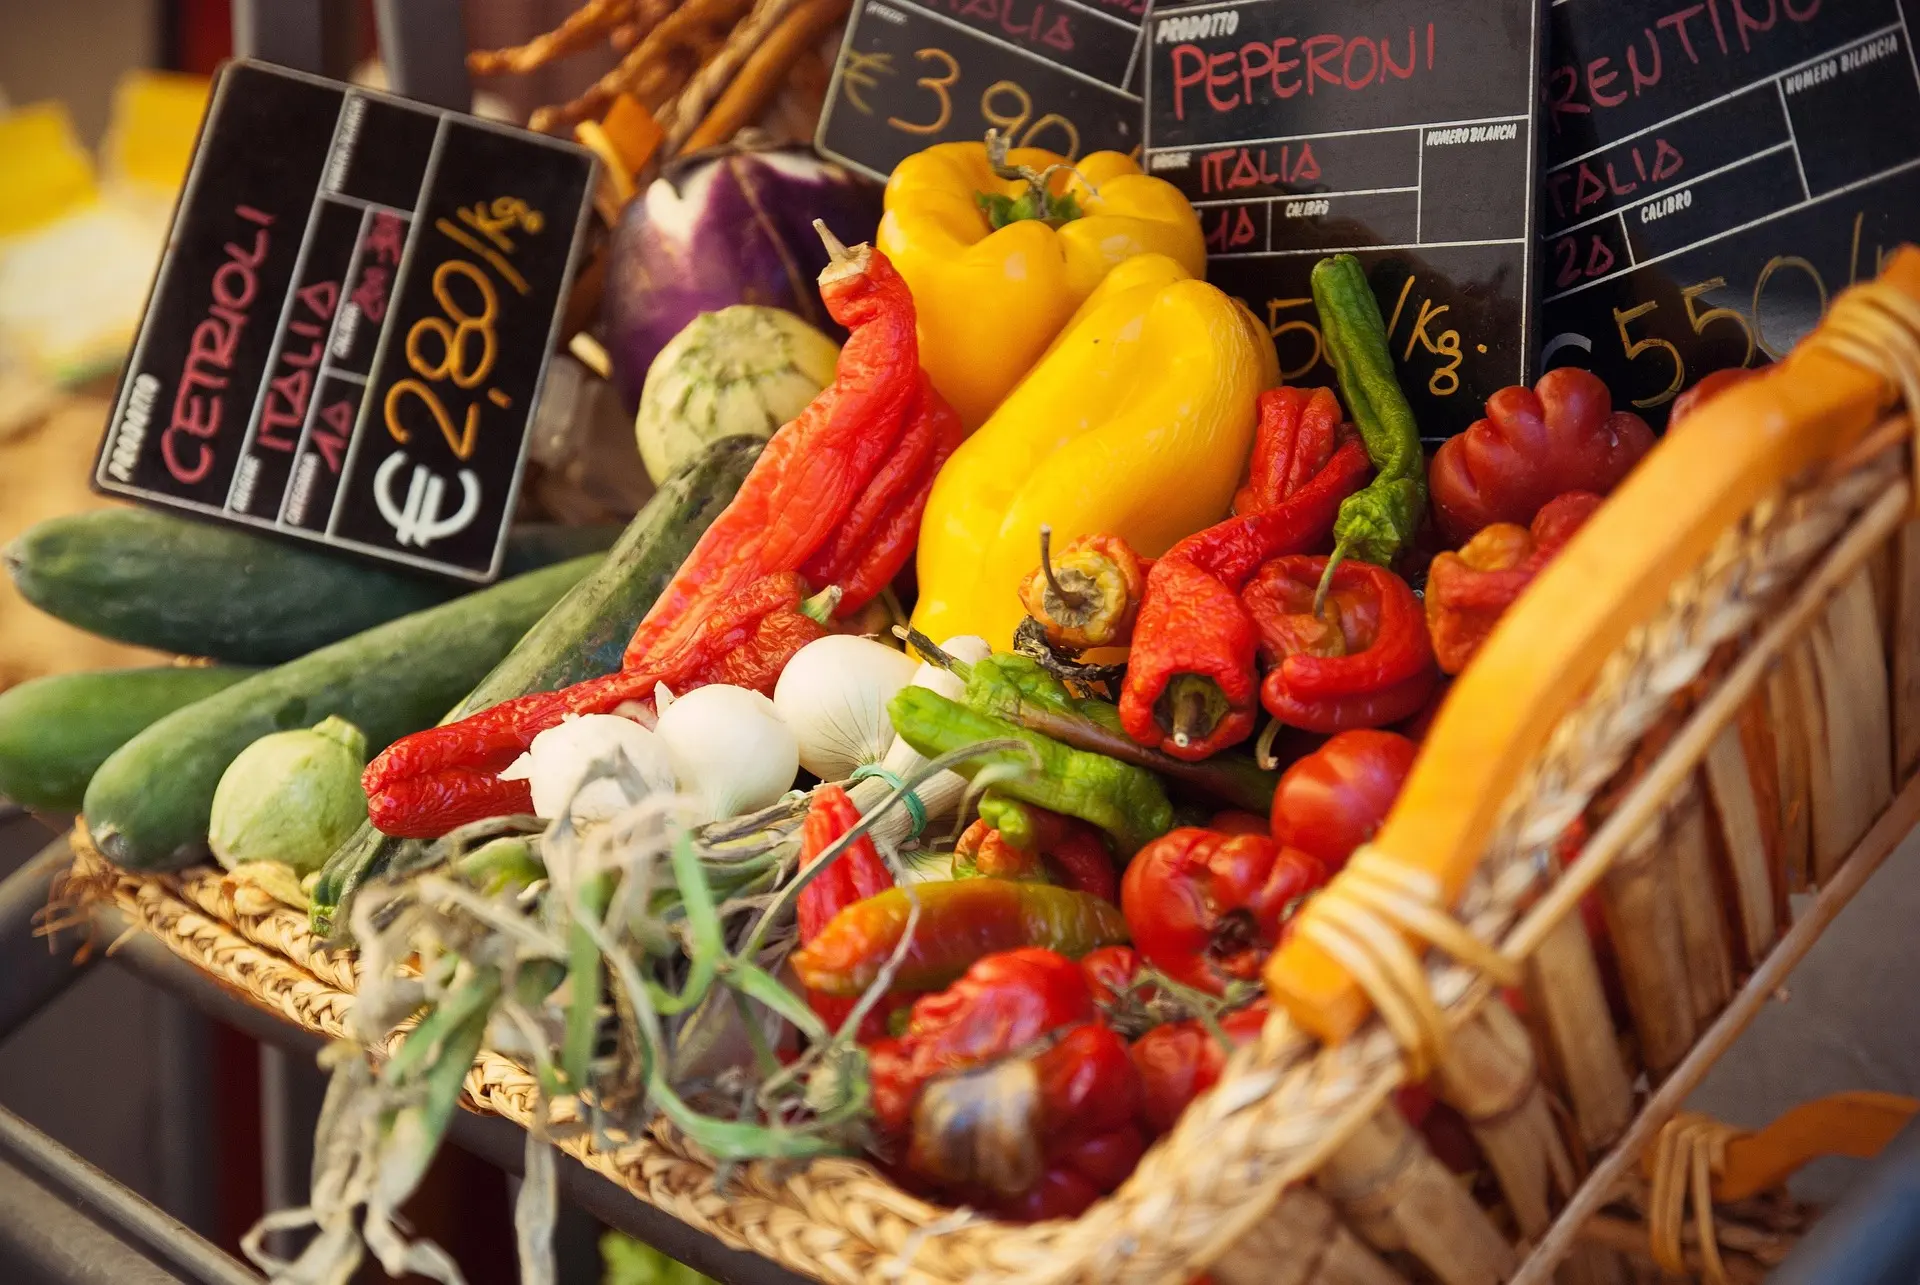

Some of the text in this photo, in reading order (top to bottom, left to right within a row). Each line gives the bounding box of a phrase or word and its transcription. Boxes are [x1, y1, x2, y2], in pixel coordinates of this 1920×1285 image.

[1156, 11, 1239, 43] PRODOTTO
[1170, 22, 1435, 121] PEPERONI
[1786, 33, 1899, 95] NUMERO BILANCIA
[1426, 123, 1518, 146] NUMERO BILANCIA
[1201, 140, 1322, 194] ITALIA
[1285, 199, 1330, 219] CALIBRO
[1640, 189, 1692, 223] CALIBRO
[161, 204, 277, 485] CETRIOLI
[256, 280, 341, 453] ITALIA
[107, 373, 162, 482] PRODOTTO
[373, 450, 482, 547] €
